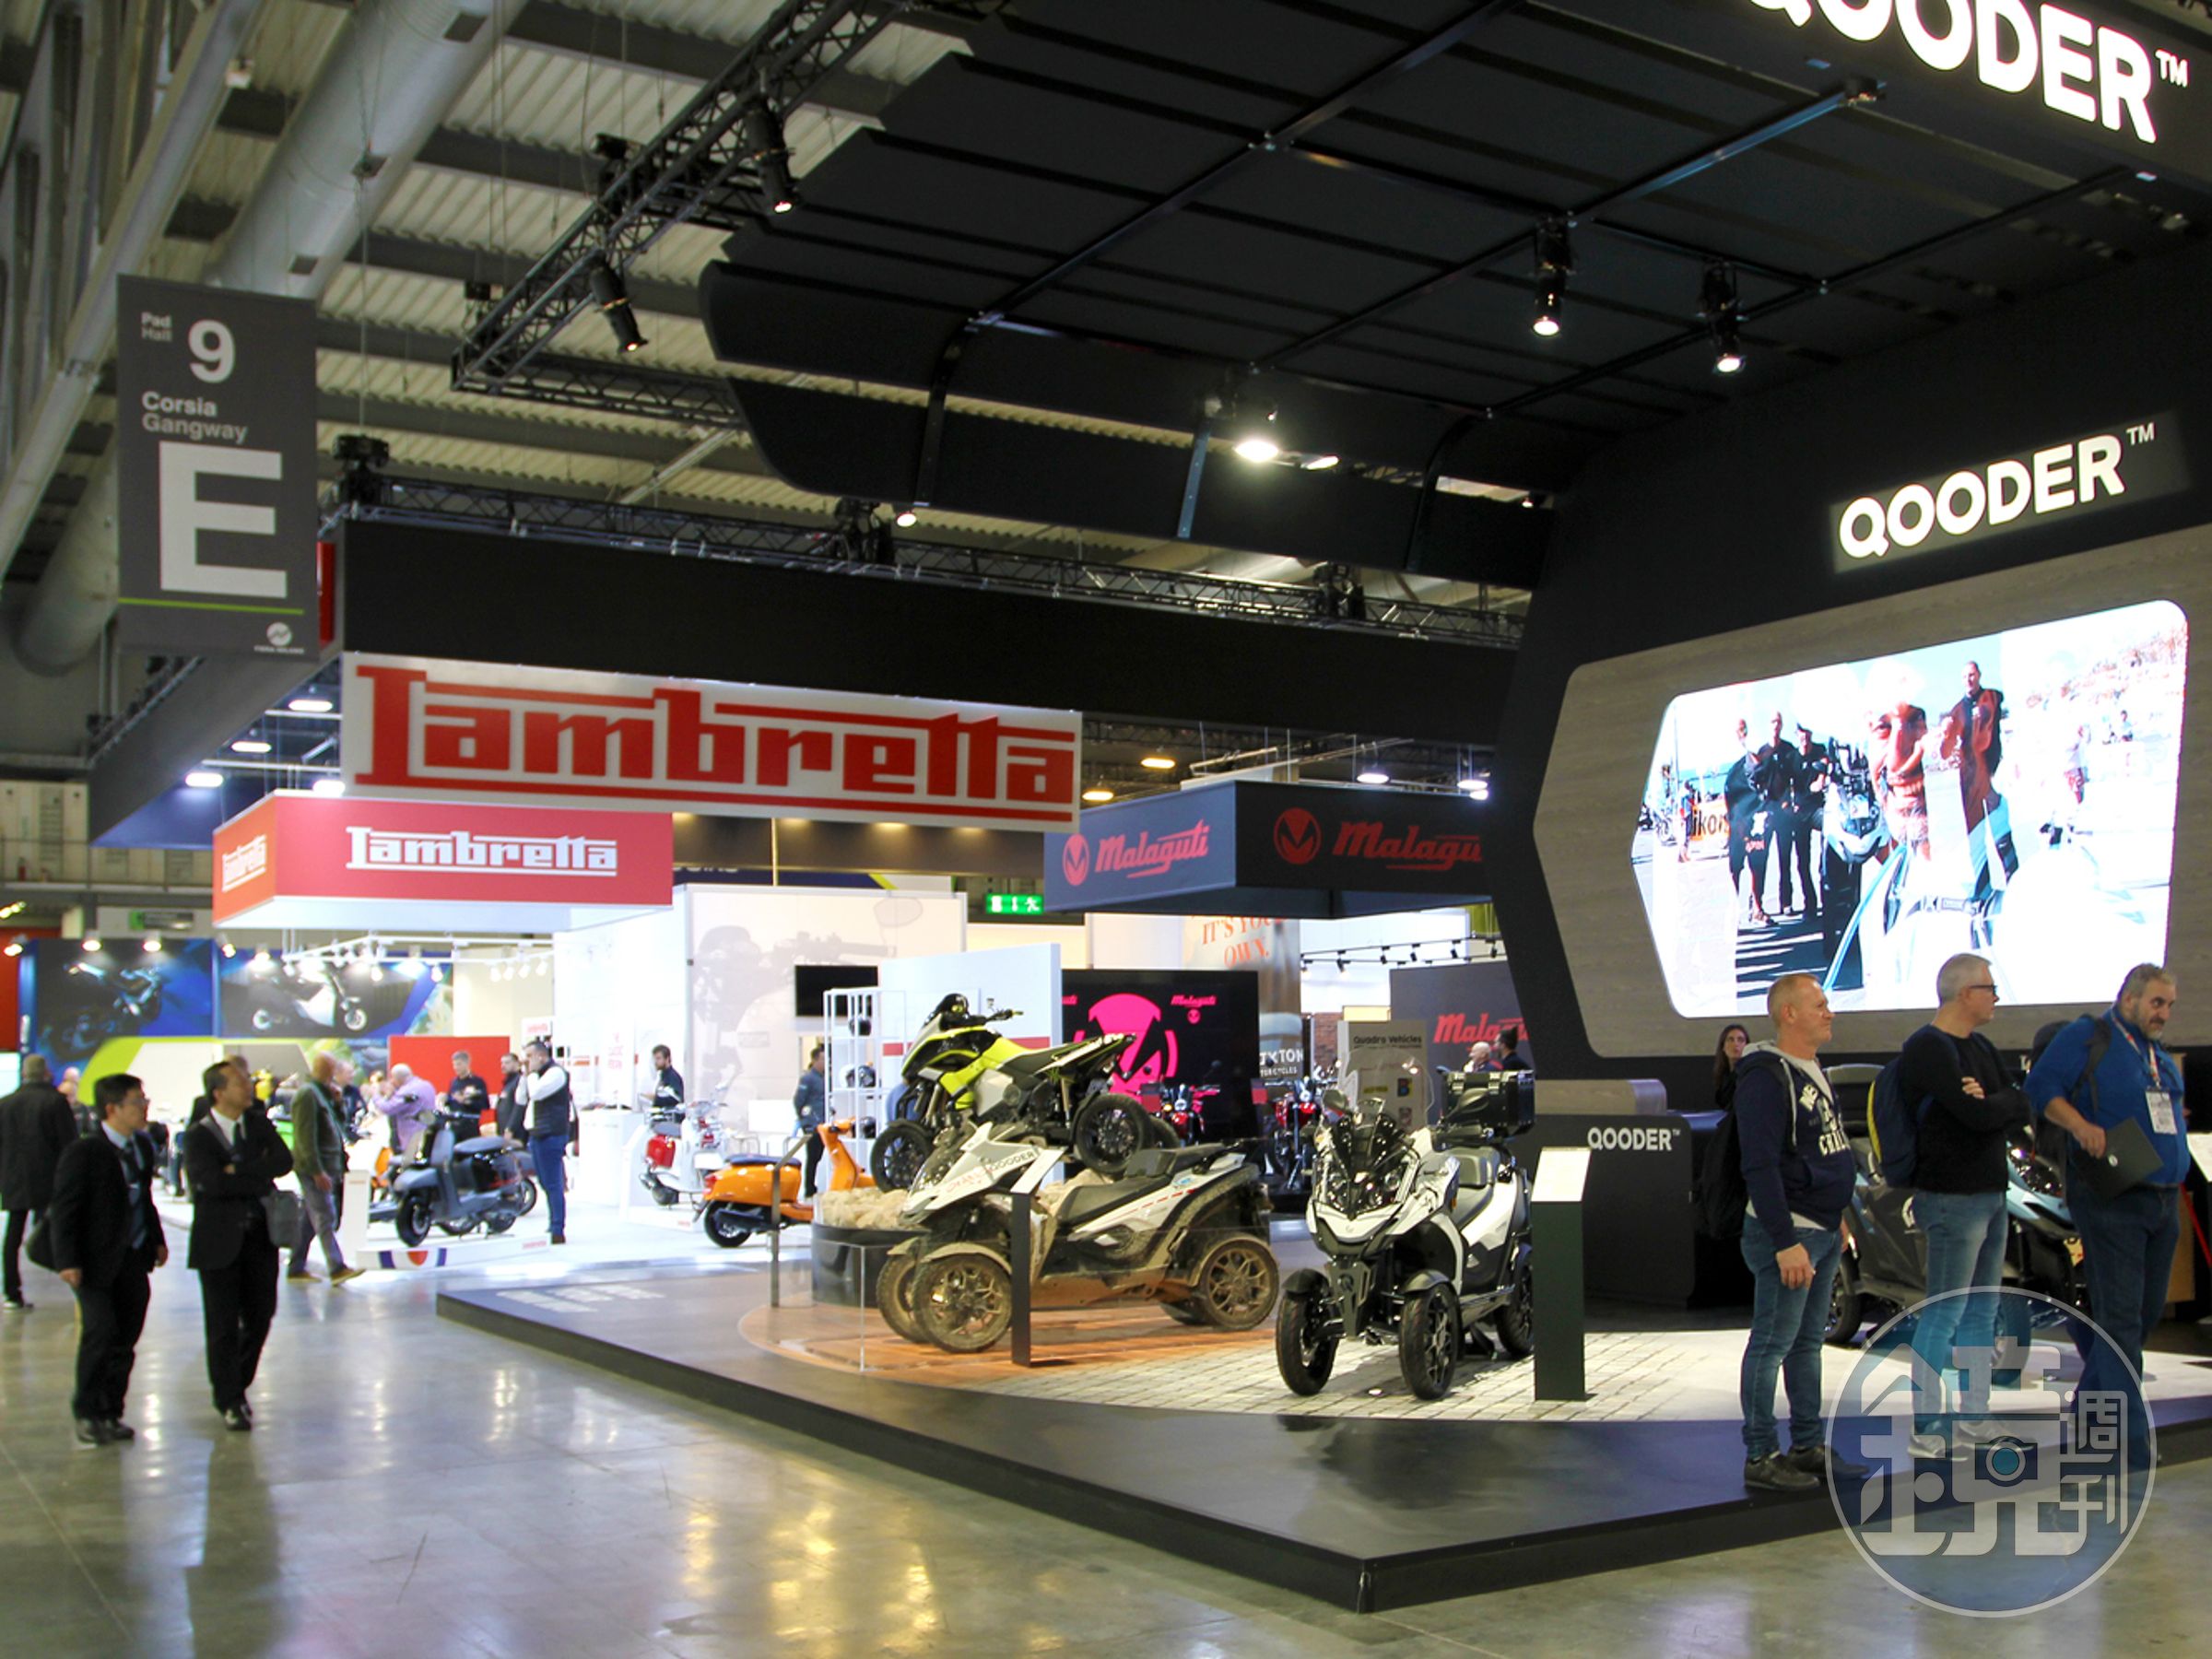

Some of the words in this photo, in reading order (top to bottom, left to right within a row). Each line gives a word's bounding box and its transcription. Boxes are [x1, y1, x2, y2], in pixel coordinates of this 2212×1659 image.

[1752, 0, 2157, 143] ODER
[188, 319, 236, 383] 9
[141, 390, 218, 418] Corsia
[142, 411, 248, 444] Gangway
[159, 441, 287, 599] E
[1840, 434, 2125, 559] QOODER
[356, 665, 1076, 823] Lambretta
[346, 826, 618, 877] Lambretta
[1094, 818, 1210, 879] Malaguti
[1333, 821, 1483, 870] Malagu
[1587, 1126, 1673, 1151] QOODER
